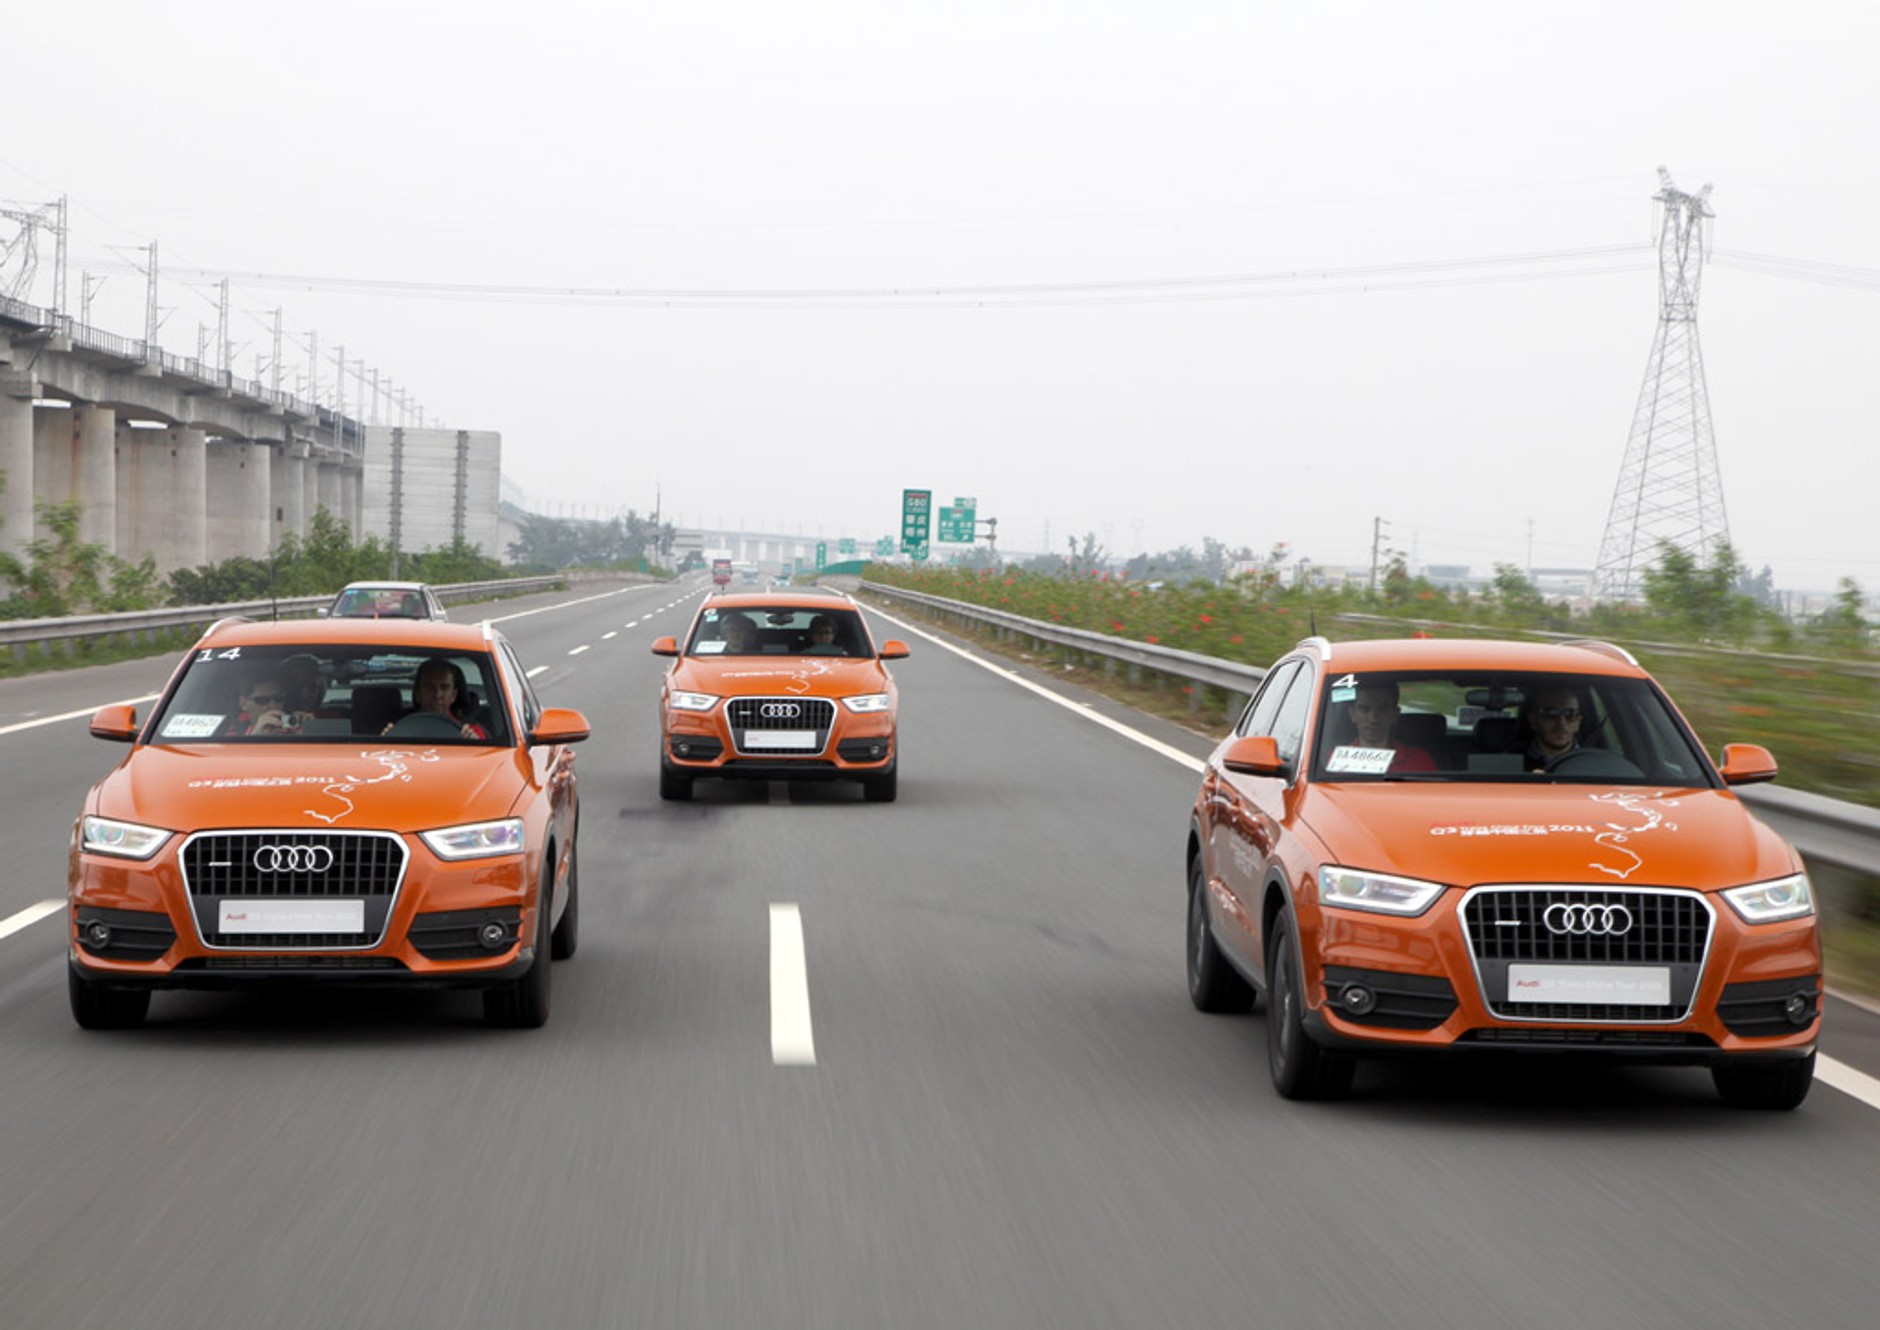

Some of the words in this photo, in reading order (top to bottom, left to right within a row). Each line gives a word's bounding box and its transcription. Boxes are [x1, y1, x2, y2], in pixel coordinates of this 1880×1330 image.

[195, 647, 241, 662] 14
[1332, 673, 1359, 688] 4
[225, 912, 247, 921] Audi
[1515, 979, 1541, 988] Audi
